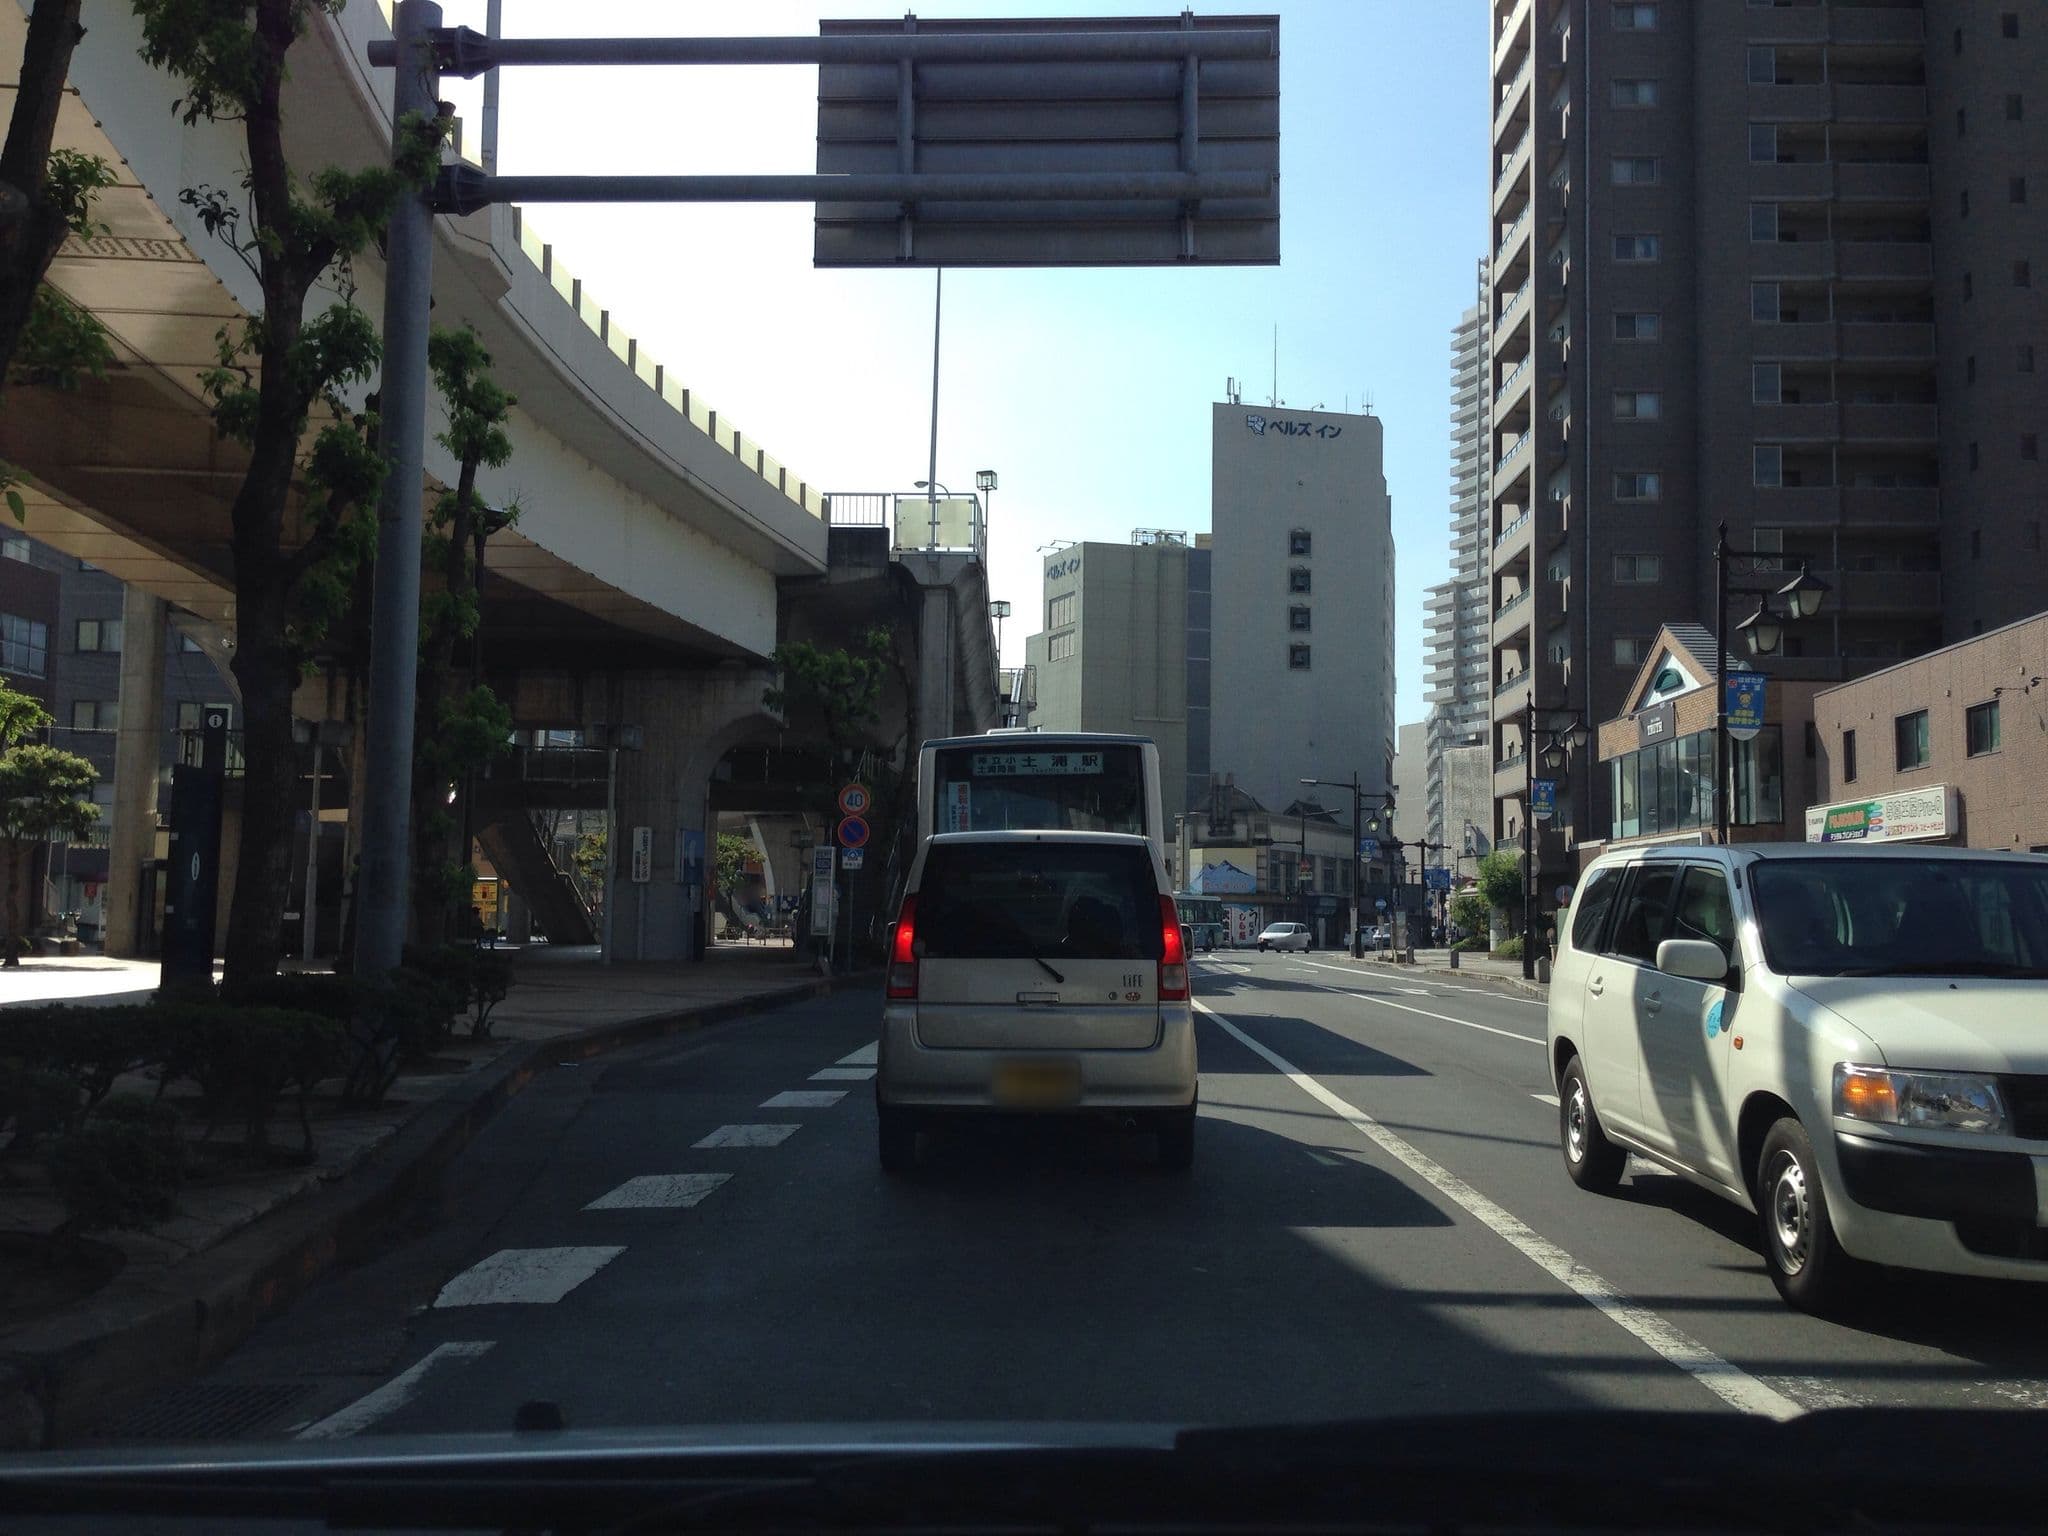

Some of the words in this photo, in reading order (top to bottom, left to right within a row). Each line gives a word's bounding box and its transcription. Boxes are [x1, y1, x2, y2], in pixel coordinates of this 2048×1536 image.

[1022, 755, 1099, 768] 土浦駅
[846, 793, 864, 808] 40
